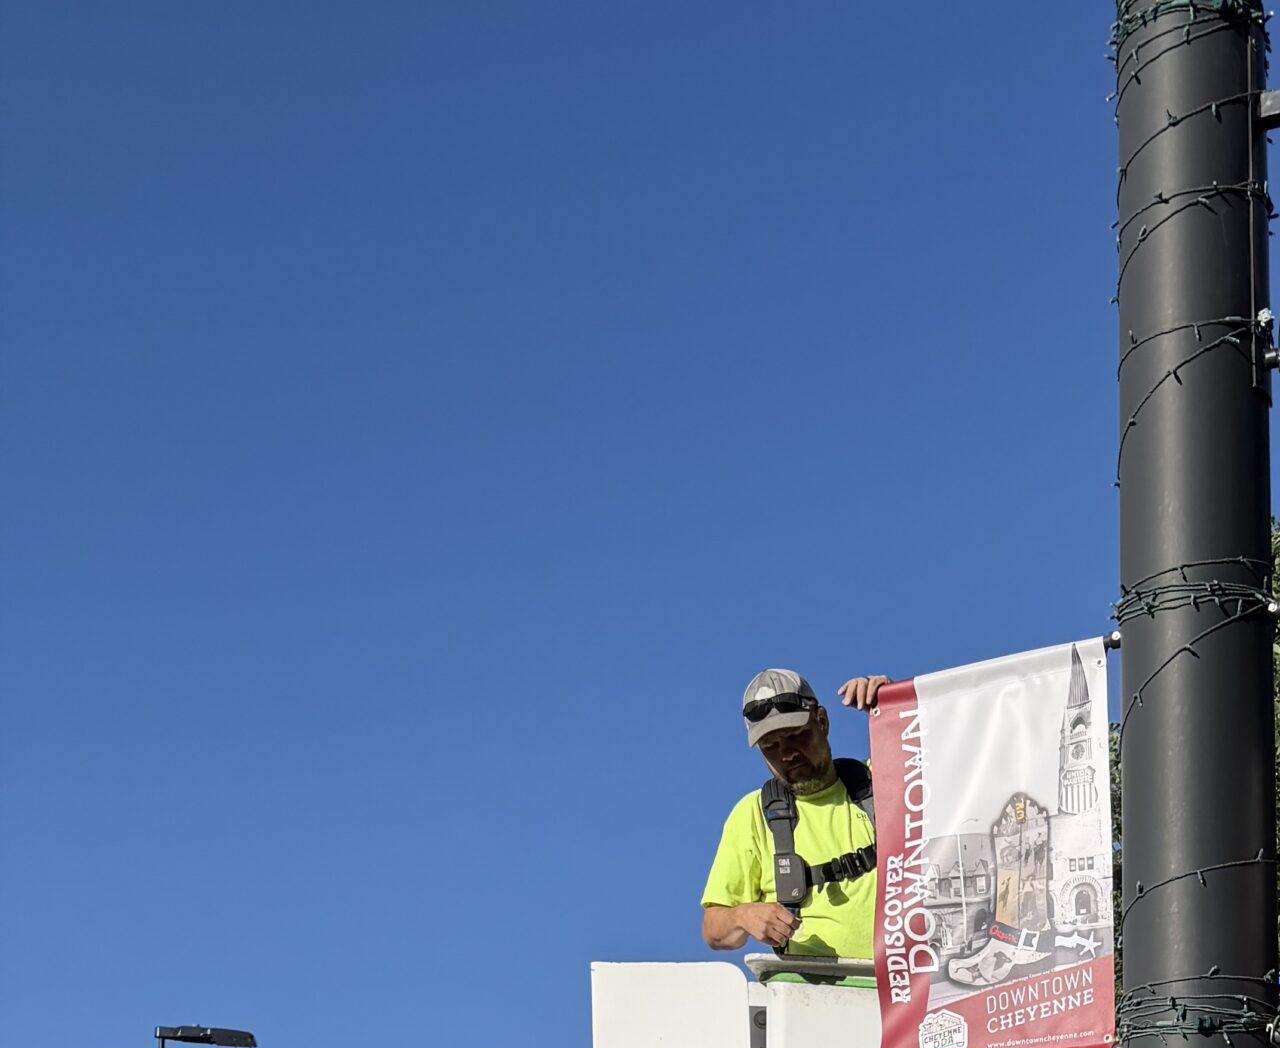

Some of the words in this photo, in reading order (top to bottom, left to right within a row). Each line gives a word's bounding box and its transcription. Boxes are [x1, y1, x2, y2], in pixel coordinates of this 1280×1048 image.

[899, 708, 939, 974] DOWNTOWN
[884, 853, 911, 1004] REDISCOVER
[986, 967, 1093, 1014] DOWNTOWN
[987, 989, 1094, 1033] CHEYENNE
[924, 1026, 962, 1044] CHEYENNE
[987, 1031, 1095, 1048] www.downtowncheyenne.com
